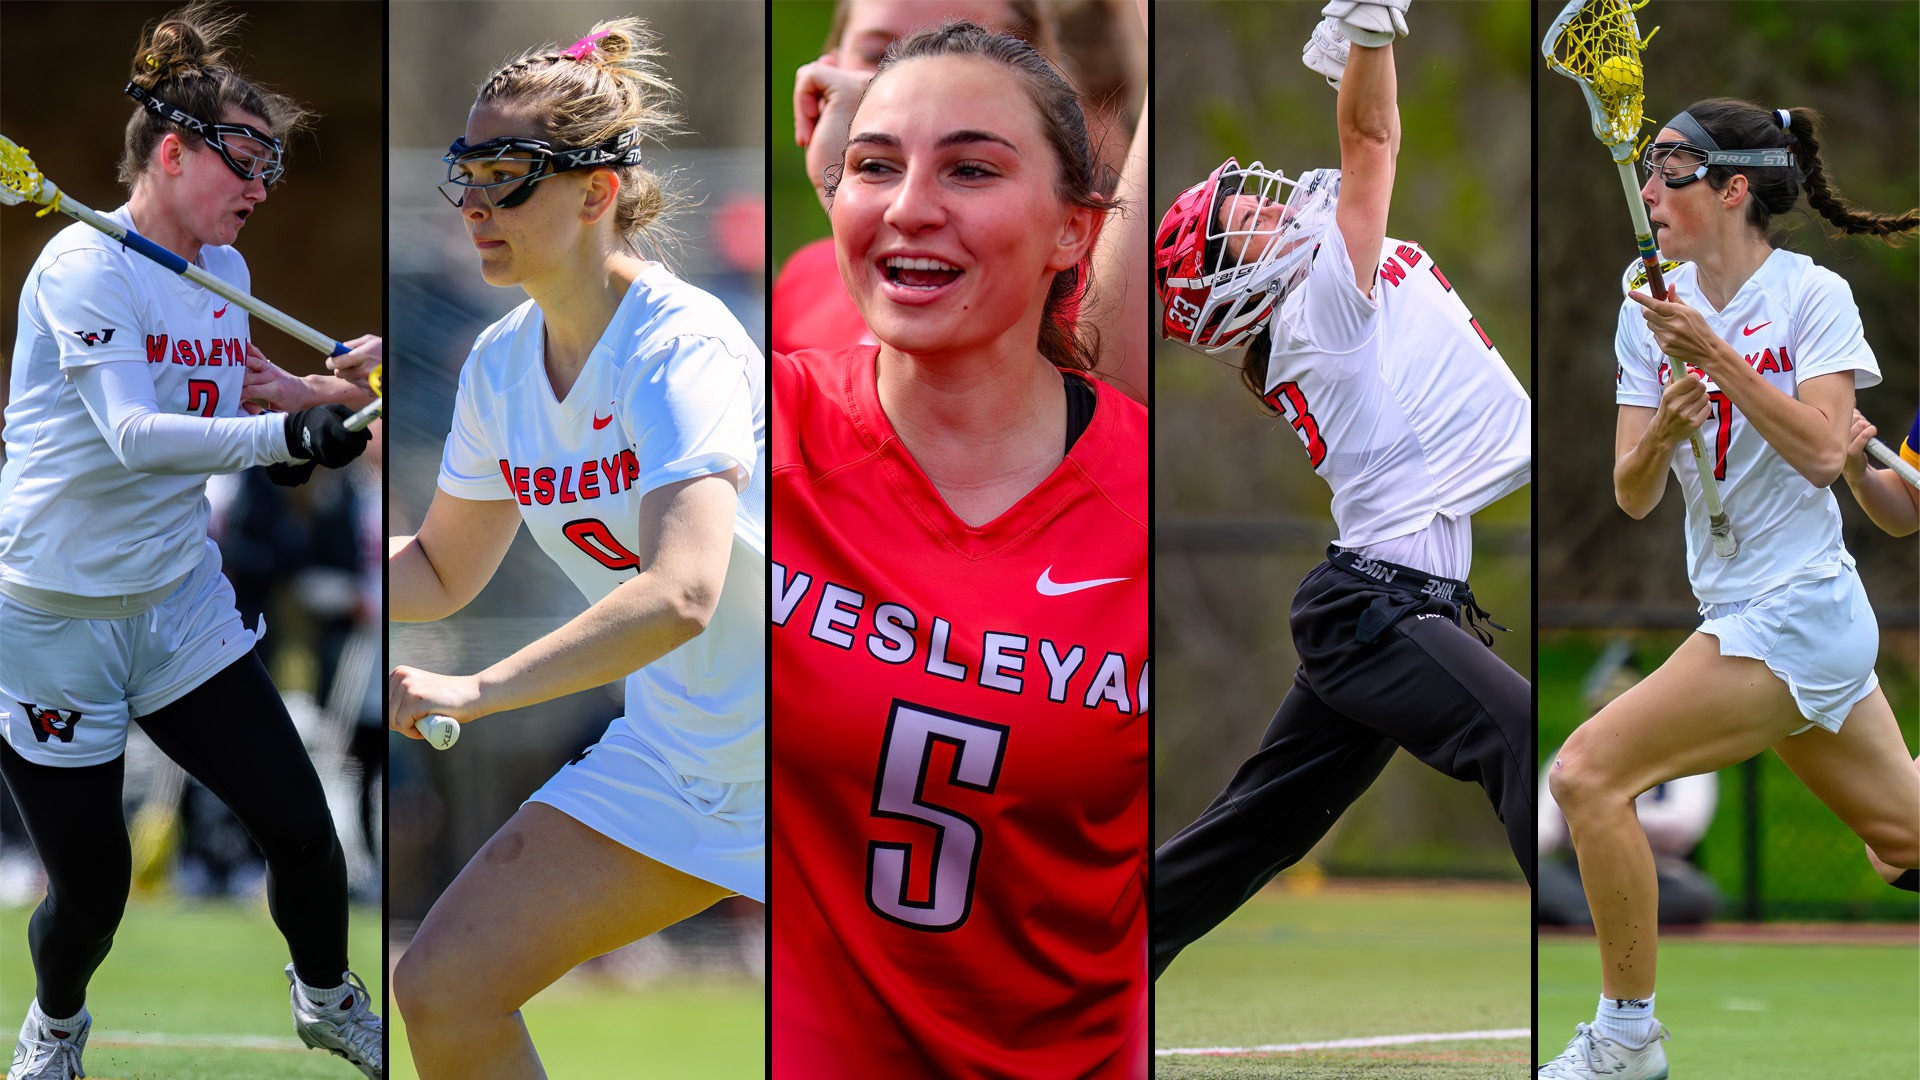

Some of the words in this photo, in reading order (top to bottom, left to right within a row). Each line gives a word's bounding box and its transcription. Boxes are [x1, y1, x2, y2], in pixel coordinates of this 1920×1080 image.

[147, 96, 165, 113] TX
[169, 109, 208, 133] STX
[616, 126, 640, 150] ST
[622, 148, 642, 162] ST
[1714, 154, 1752, 164] PRO
[1379, 240, 1425, 288] WE
[1168, 294, 1201, 331] 33
[146, 333, 248, 367] WESLEYA
[498, 448, 641, 506] ESLEYA
[1350, 555, 1398, 584] NIKE
[1420, 578, 1457, 601] NIKE
[772, 560, 1149, 716] ESLEYA
[441, 723, 453, 748] STX
[864, 697, 1011, 934] 5
